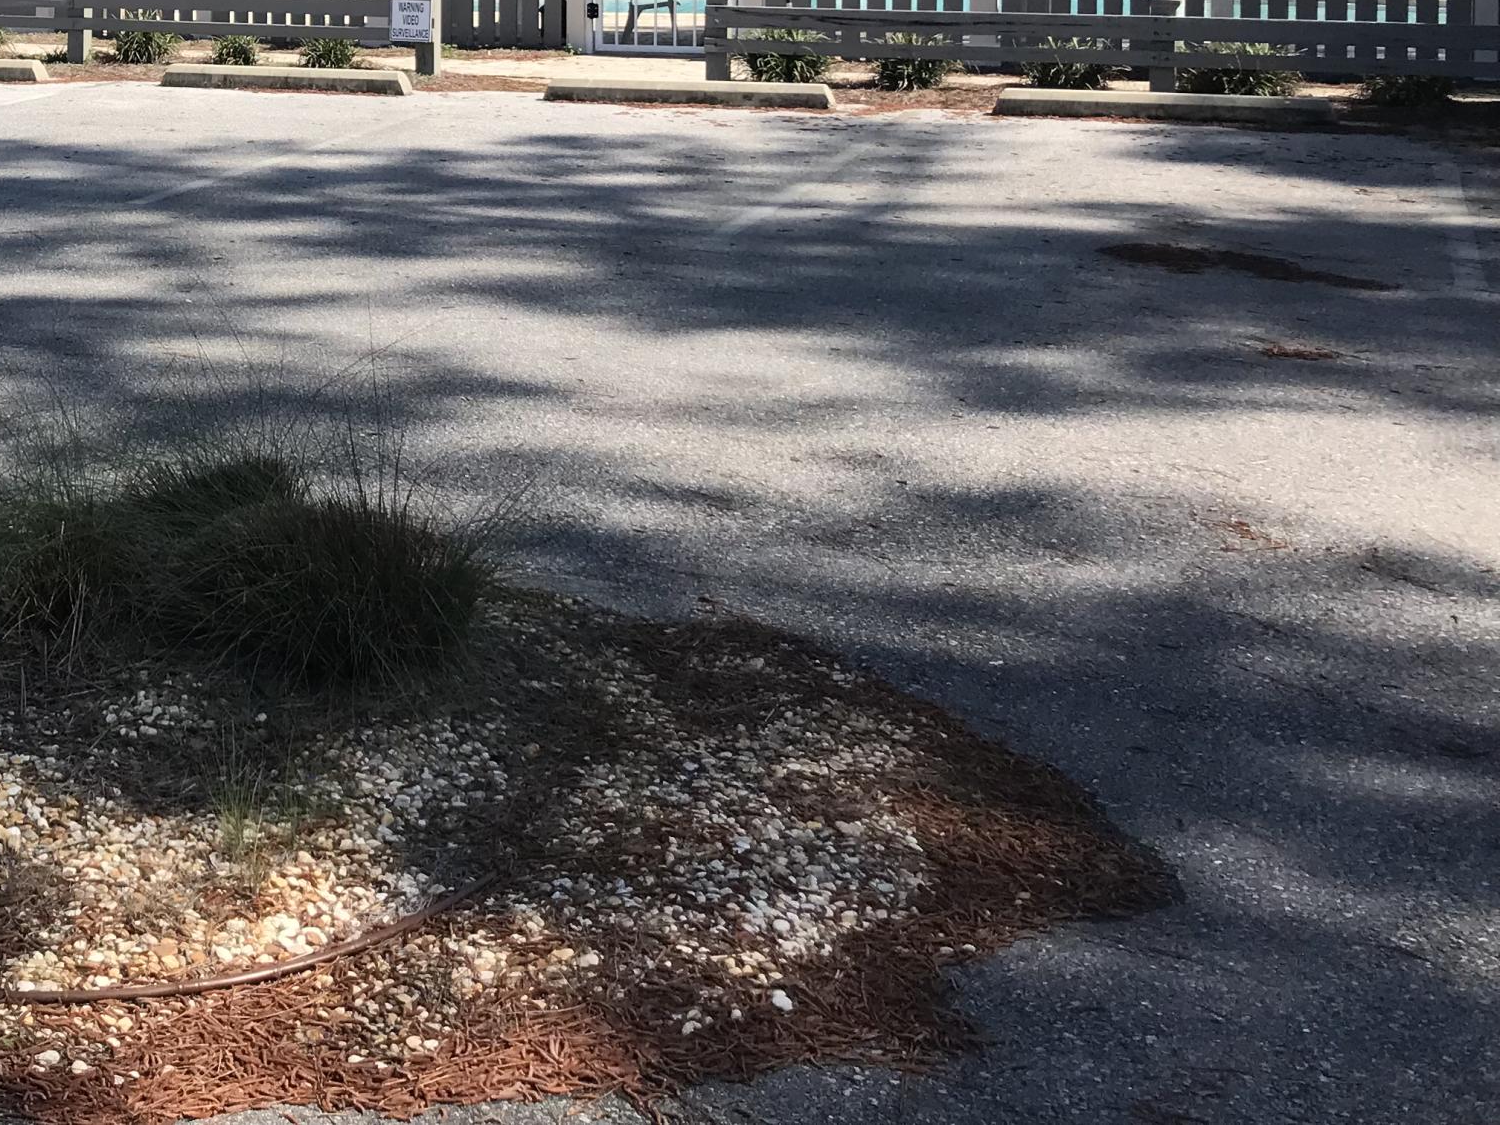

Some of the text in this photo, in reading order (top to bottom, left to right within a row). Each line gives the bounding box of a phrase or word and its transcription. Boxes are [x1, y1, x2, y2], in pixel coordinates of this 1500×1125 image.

[398, 2, 425, 14] WARNING
[402, 14, 420, 26] VIDEO
[392, 27, 429, 39] SURVEILLANCE
